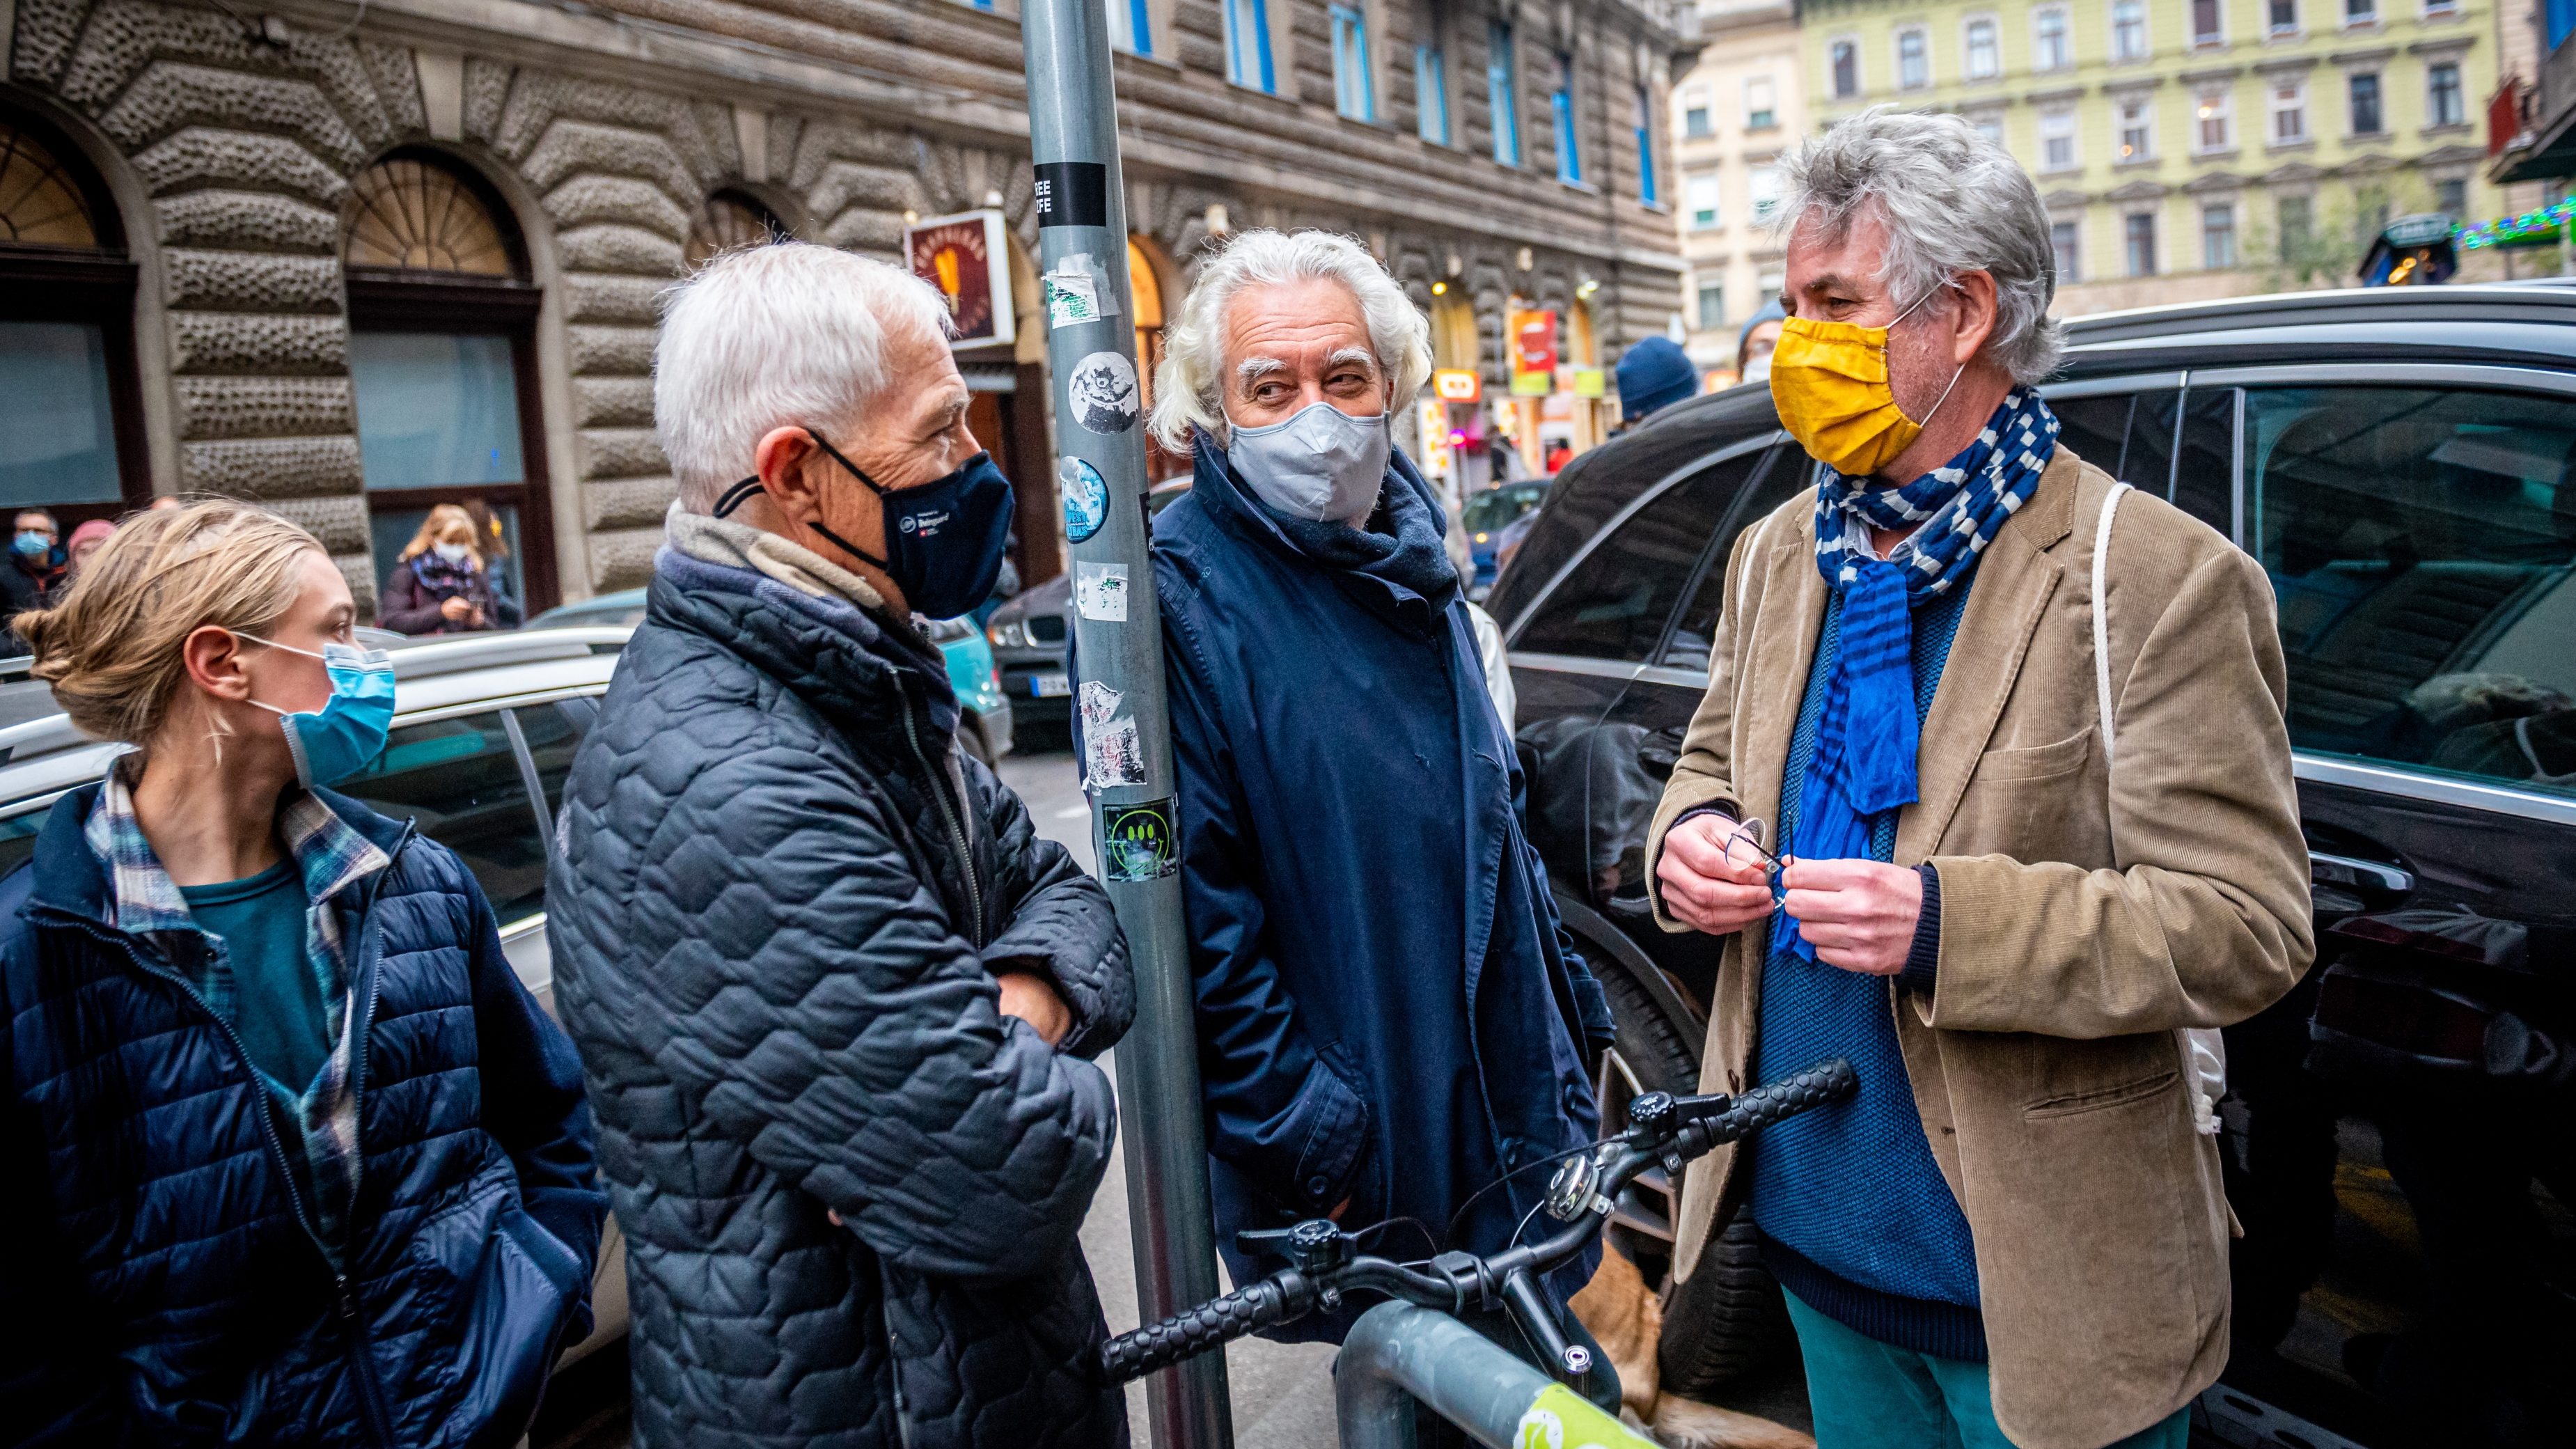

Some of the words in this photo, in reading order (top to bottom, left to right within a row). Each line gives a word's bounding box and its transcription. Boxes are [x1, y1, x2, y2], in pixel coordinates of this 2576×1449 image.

[1035, 180, 1051, 196] REE
[1036, 198, 1051, 213] ZFE
[1066, 512, 1087, 523] PEST
